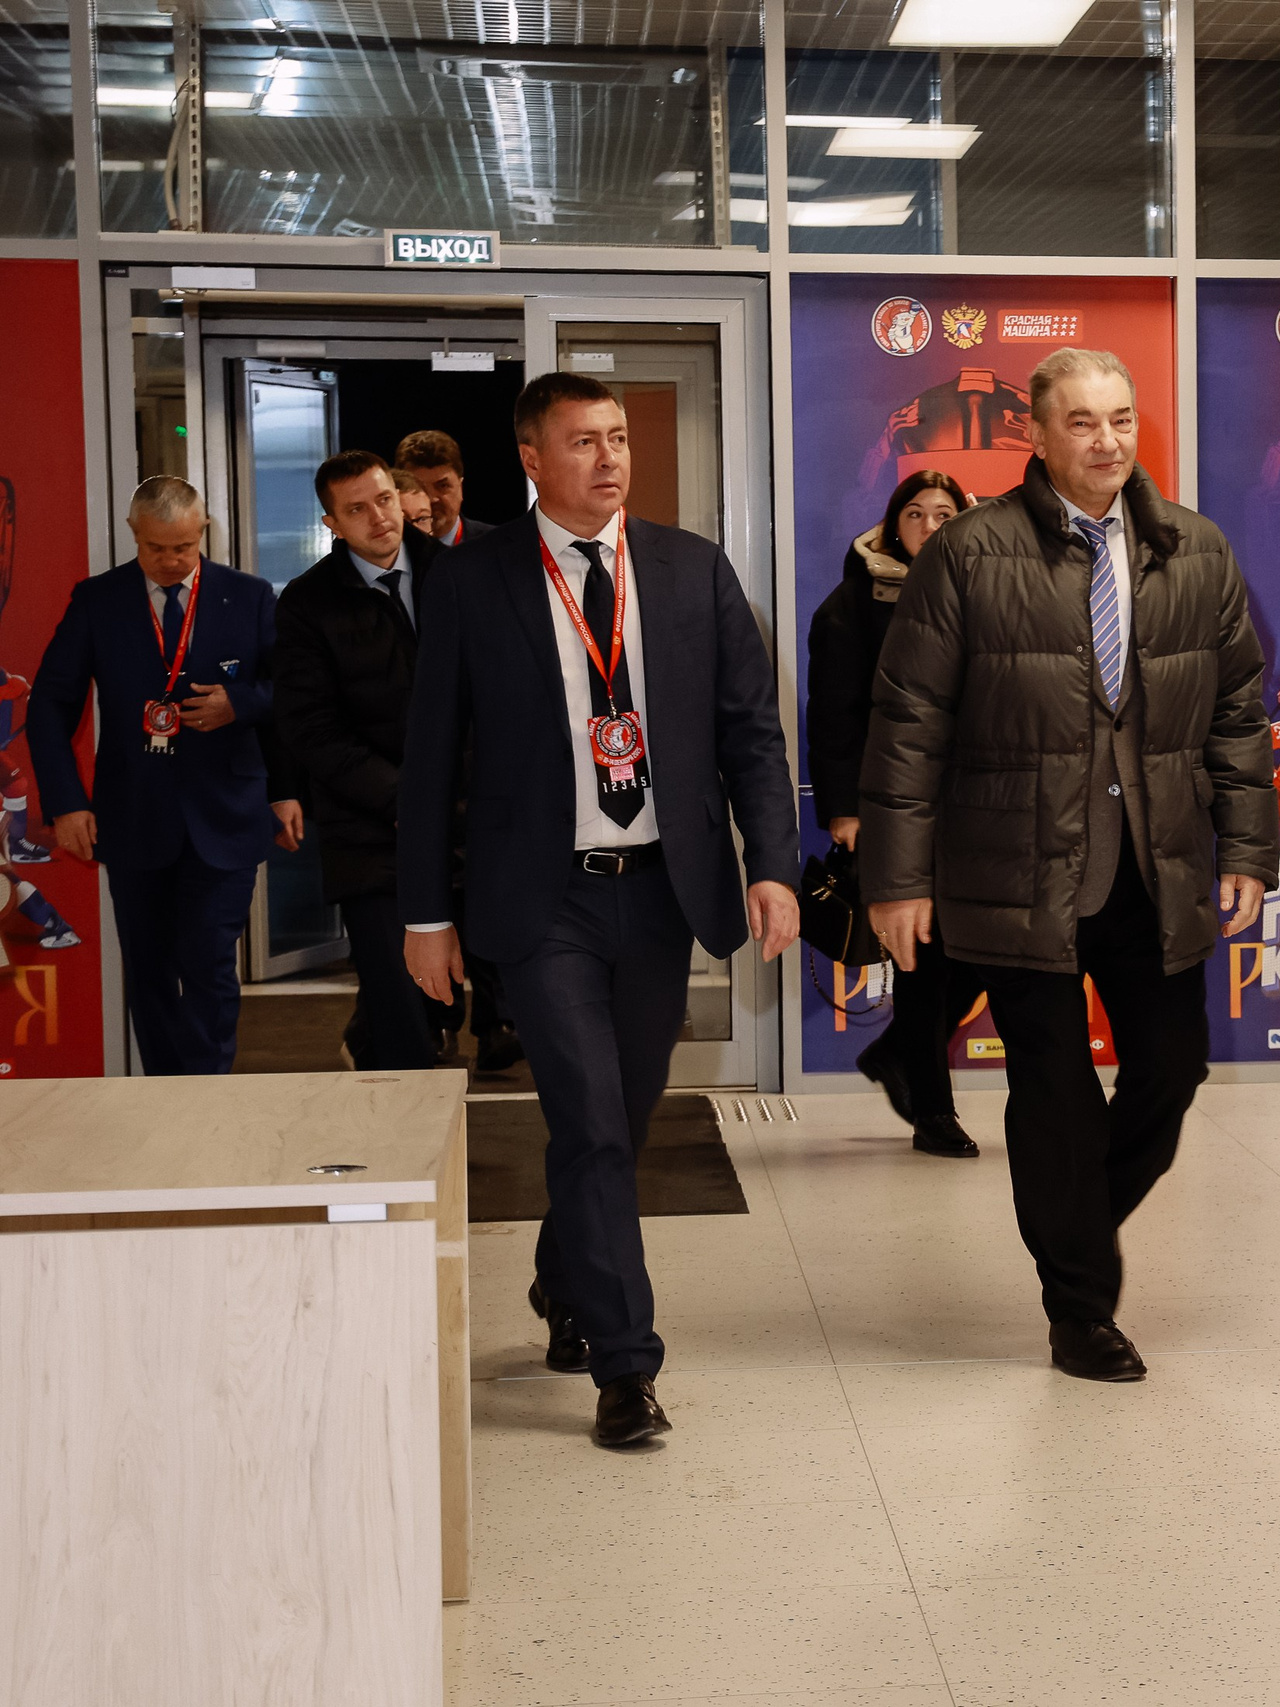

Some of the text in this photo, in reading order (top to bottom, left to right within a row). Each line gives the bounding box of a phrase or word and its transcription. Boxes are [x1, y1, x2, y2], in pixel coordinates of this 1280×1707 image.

[398, 238, 490, 260] ВЫХОД
[1004, 315, 1052, 325] КРАСНАЯ
[1002, 325, 1050, 337] МАШИНА
[567, 599, 583, 623] ХОККЕЯ
[579, 621, 593, 646] РОССИИ
[603, 776, 647, 793] 1 2 3 4 5
